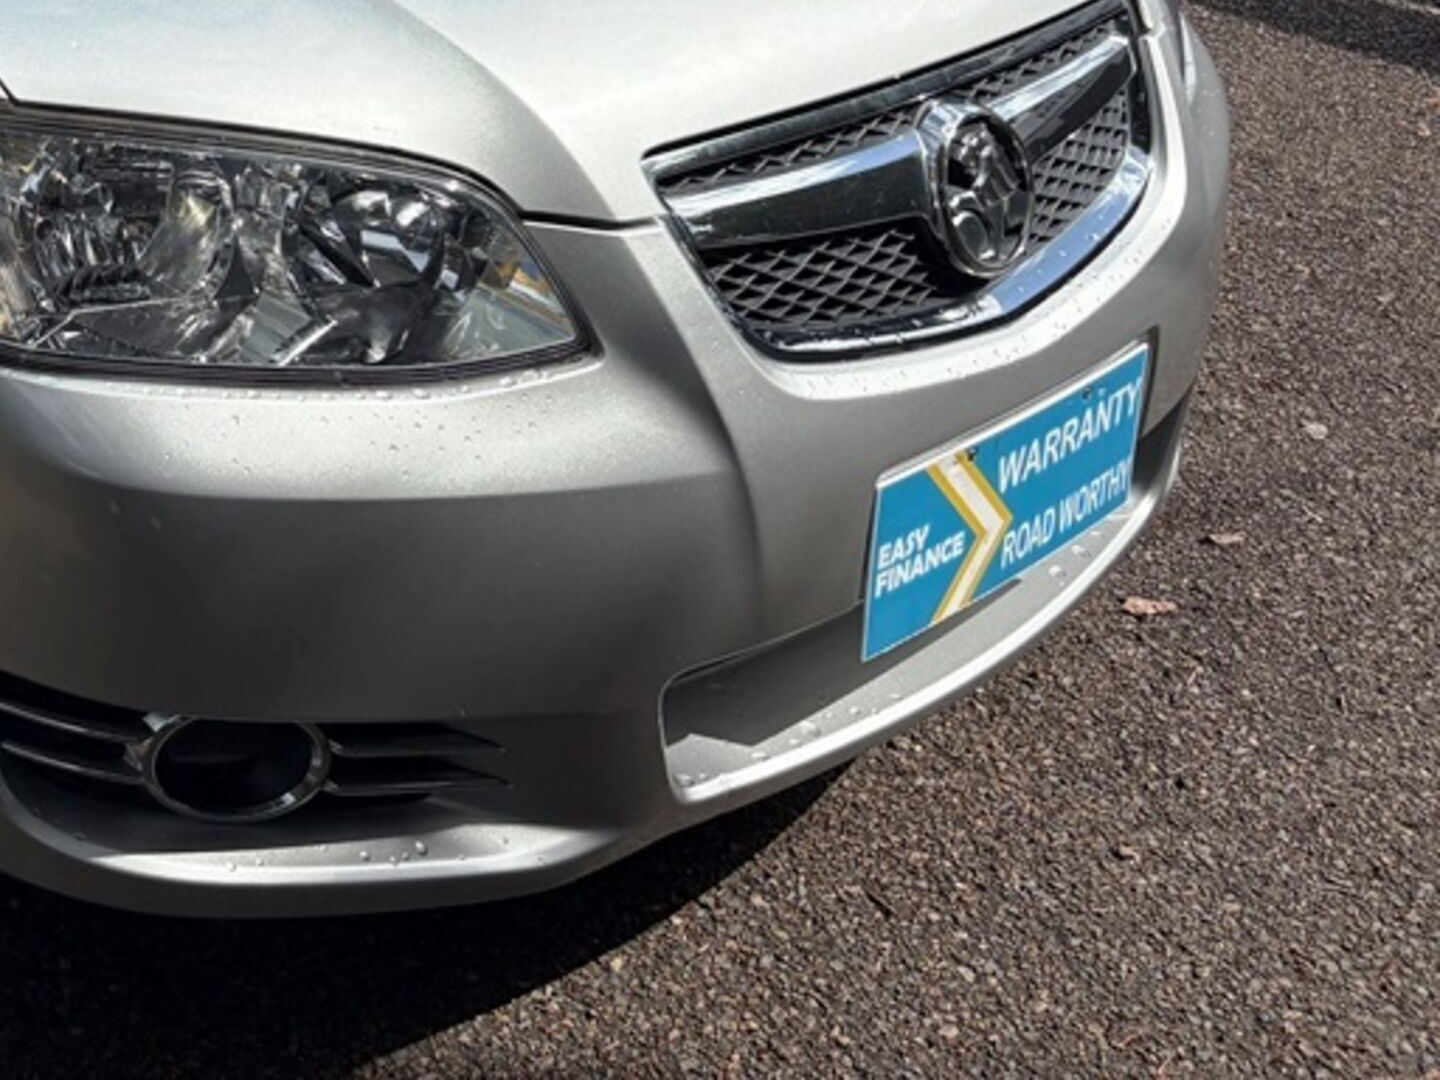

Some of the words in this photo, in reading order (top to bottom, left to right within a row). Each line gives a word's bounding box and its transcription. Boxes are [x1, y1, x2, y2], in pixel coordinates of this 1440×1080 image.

[998, 376, 1141, 493] WARRANTY
[878, 525, 929, 570] EASY
[1001, 507, 1055, 569] ROAD
[1059, 458, 1131, 532] WORTHY
[875, 531, 965, 598] FINANCE
